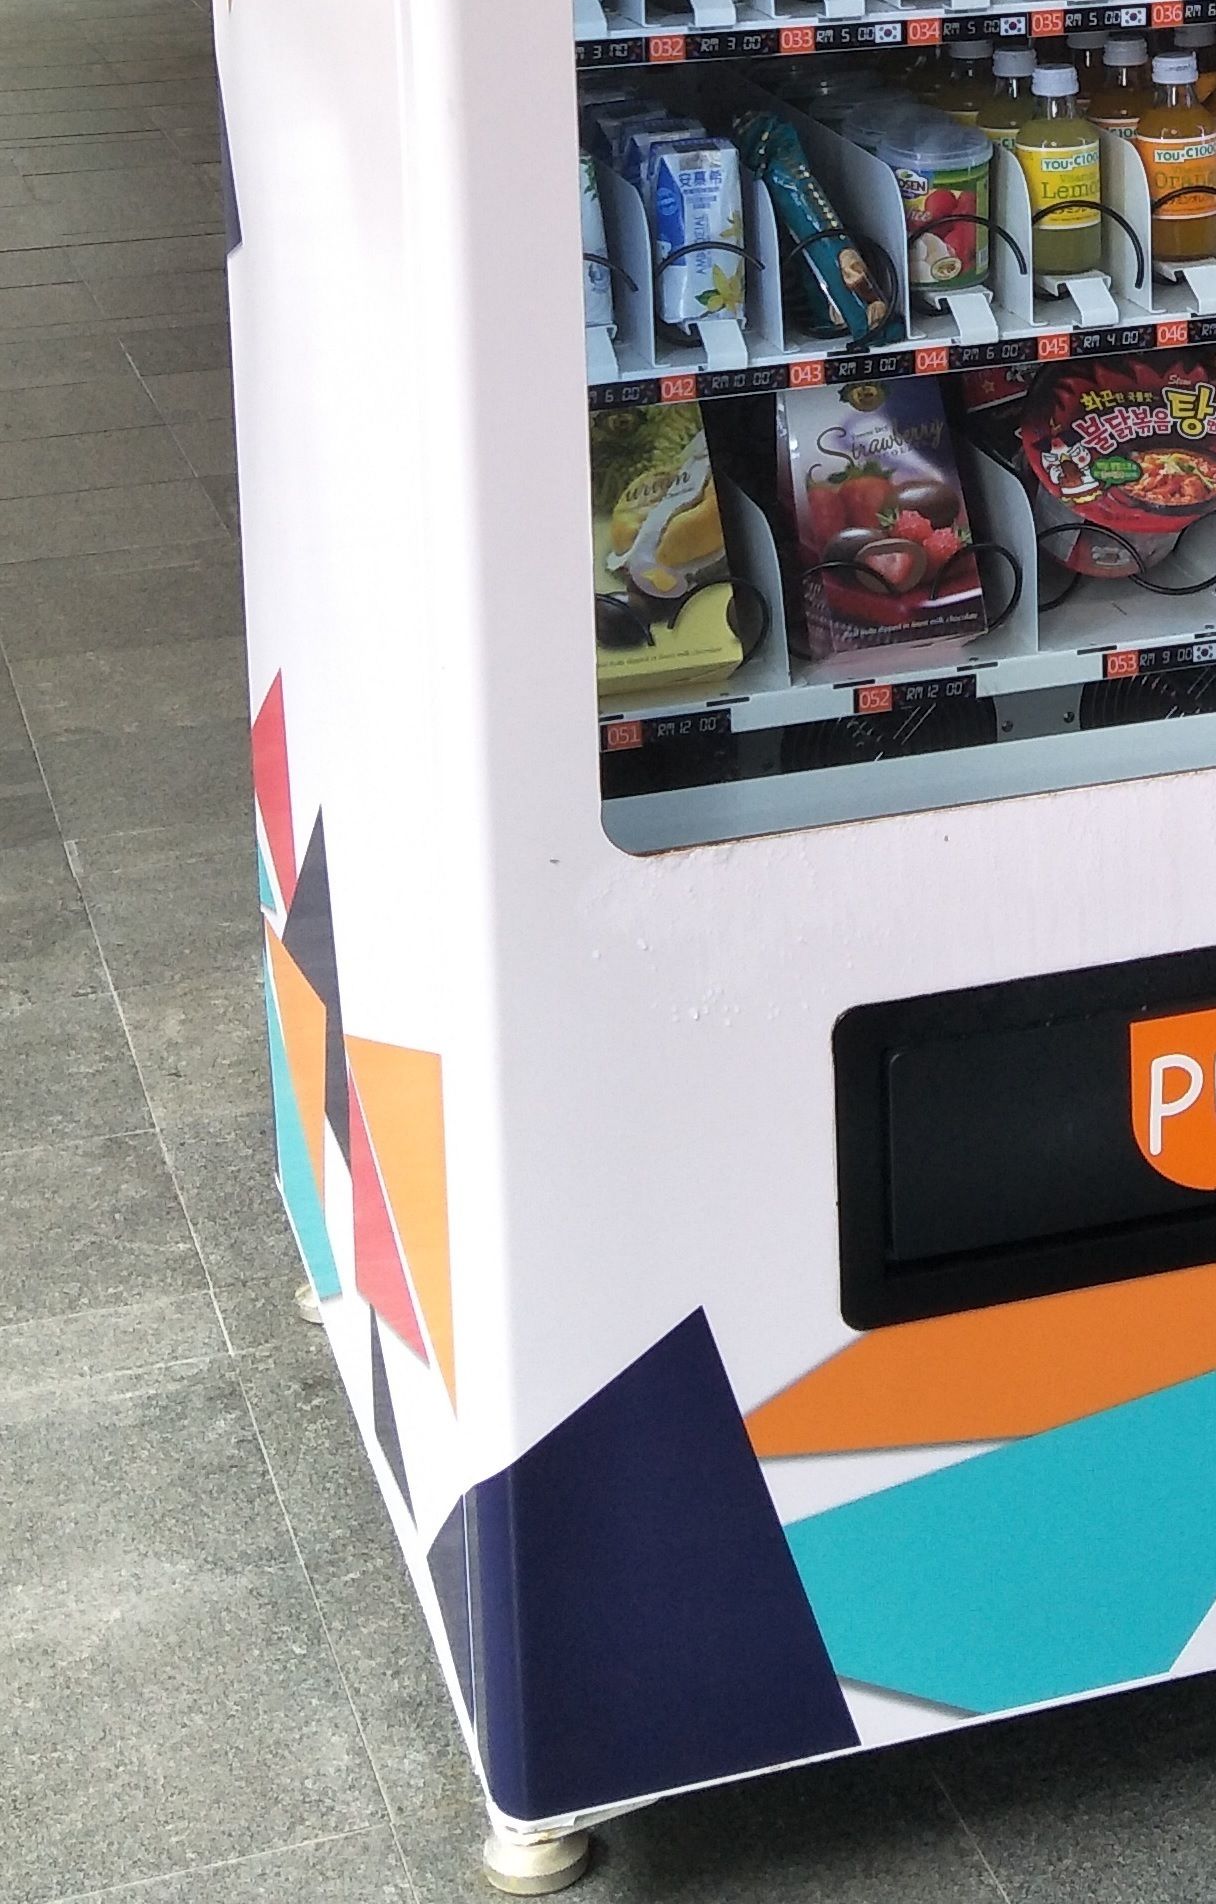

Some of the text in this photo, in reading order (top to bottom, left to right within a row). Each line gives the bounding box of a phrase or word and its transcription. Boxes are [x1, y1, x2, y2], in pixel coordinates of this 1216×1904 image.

[1033, 13, 1062, 32] 035
[1153, 5, 1182, 24] 036
[782, 30, 812, 51] 033
[909, 22, 939, 42] 034
[651, 40, 683, 59] 032
[1158, 325, 1187, 344] 046
[1039, 337, 1068, 358] 045
[917, 351, 947, 371] 044
[791, 365, 821, 385] 043
[662, 380, 693, 399] 042
[817, 424, 944, 465] Strawberry
[1108, 655, 1136, 673] 053
[860, 686, 889, 706] 052
[607, 728, 641, 747] 051
